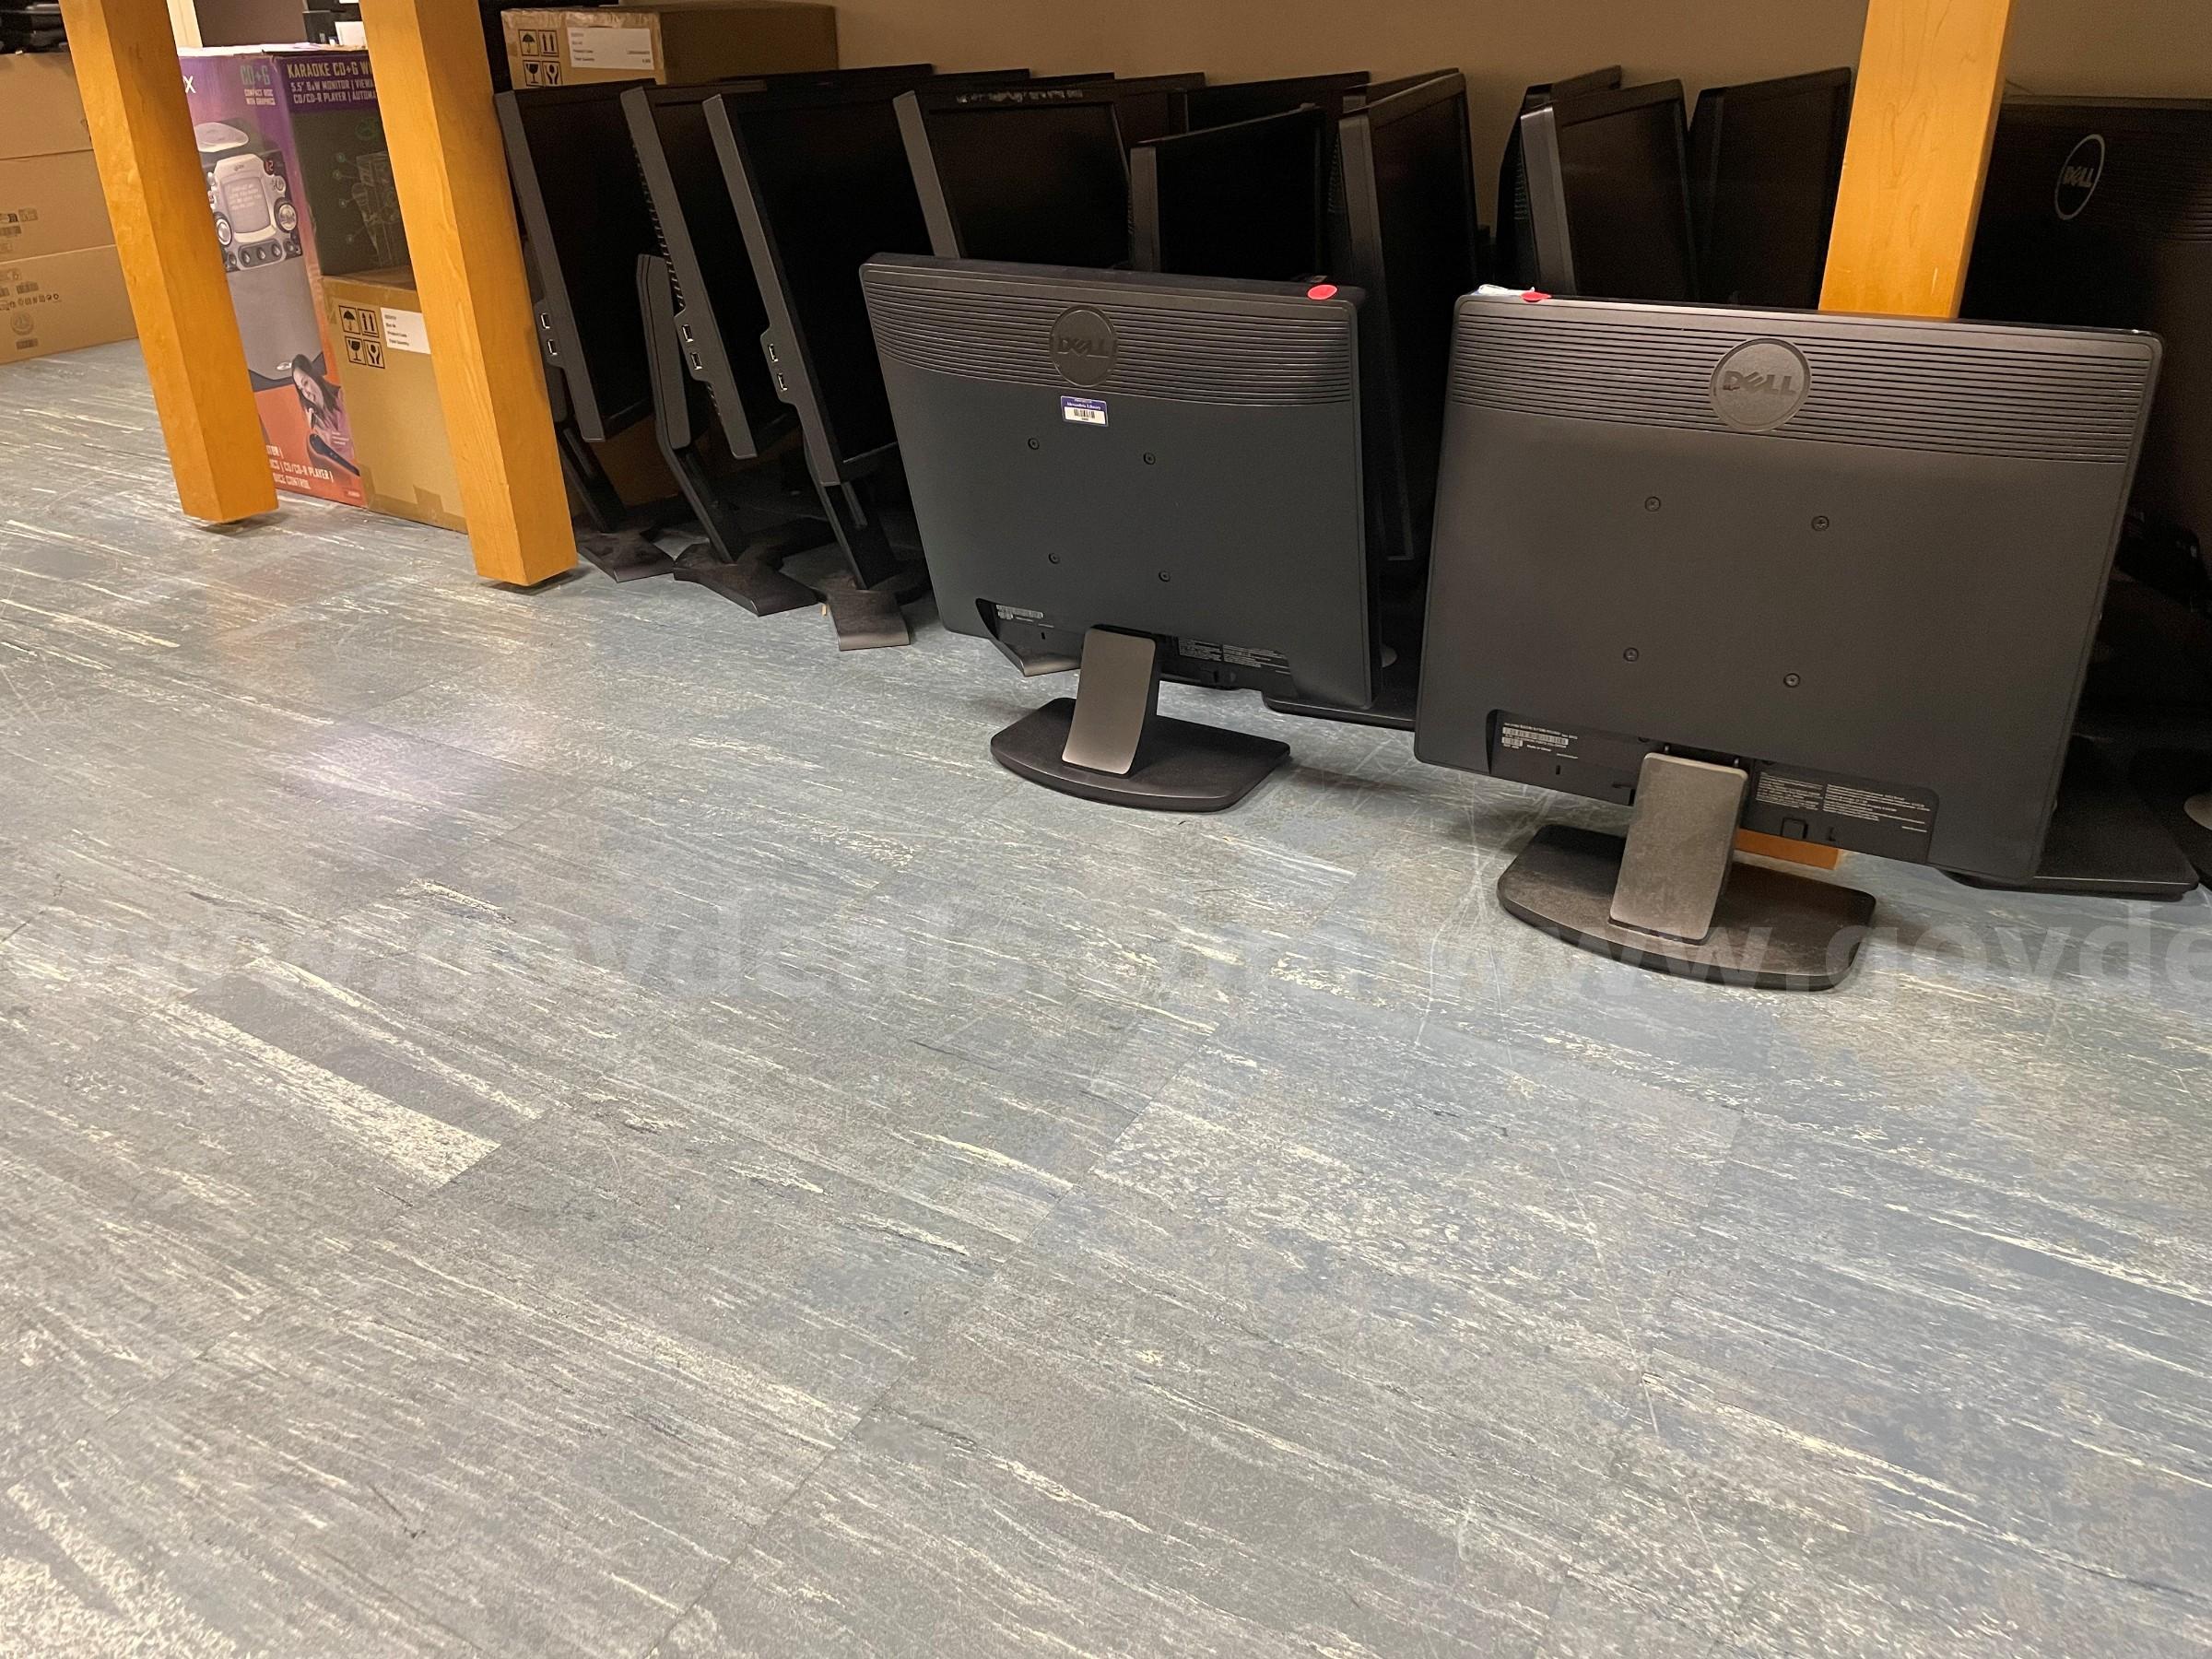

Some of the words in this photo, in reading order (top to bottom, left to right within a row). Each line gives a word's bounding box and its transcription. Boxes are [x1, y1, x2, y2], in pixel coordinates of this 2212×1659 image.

[287, 63, 331, 78] KARAOKE
[333, 62, 359, 76] CD+G
[322, 79, 350, 90] MONITOR
[293, 92, 323, 104] CD/CD-R
[324, 91, 347, 102] PLAYER
[2063, 165, 2095, 188] DELL
[1057, 337, 1109, 359] DELL
[1723, 371, 1796, 396] DELL
[308, 466, 330, 480] PLAYER
